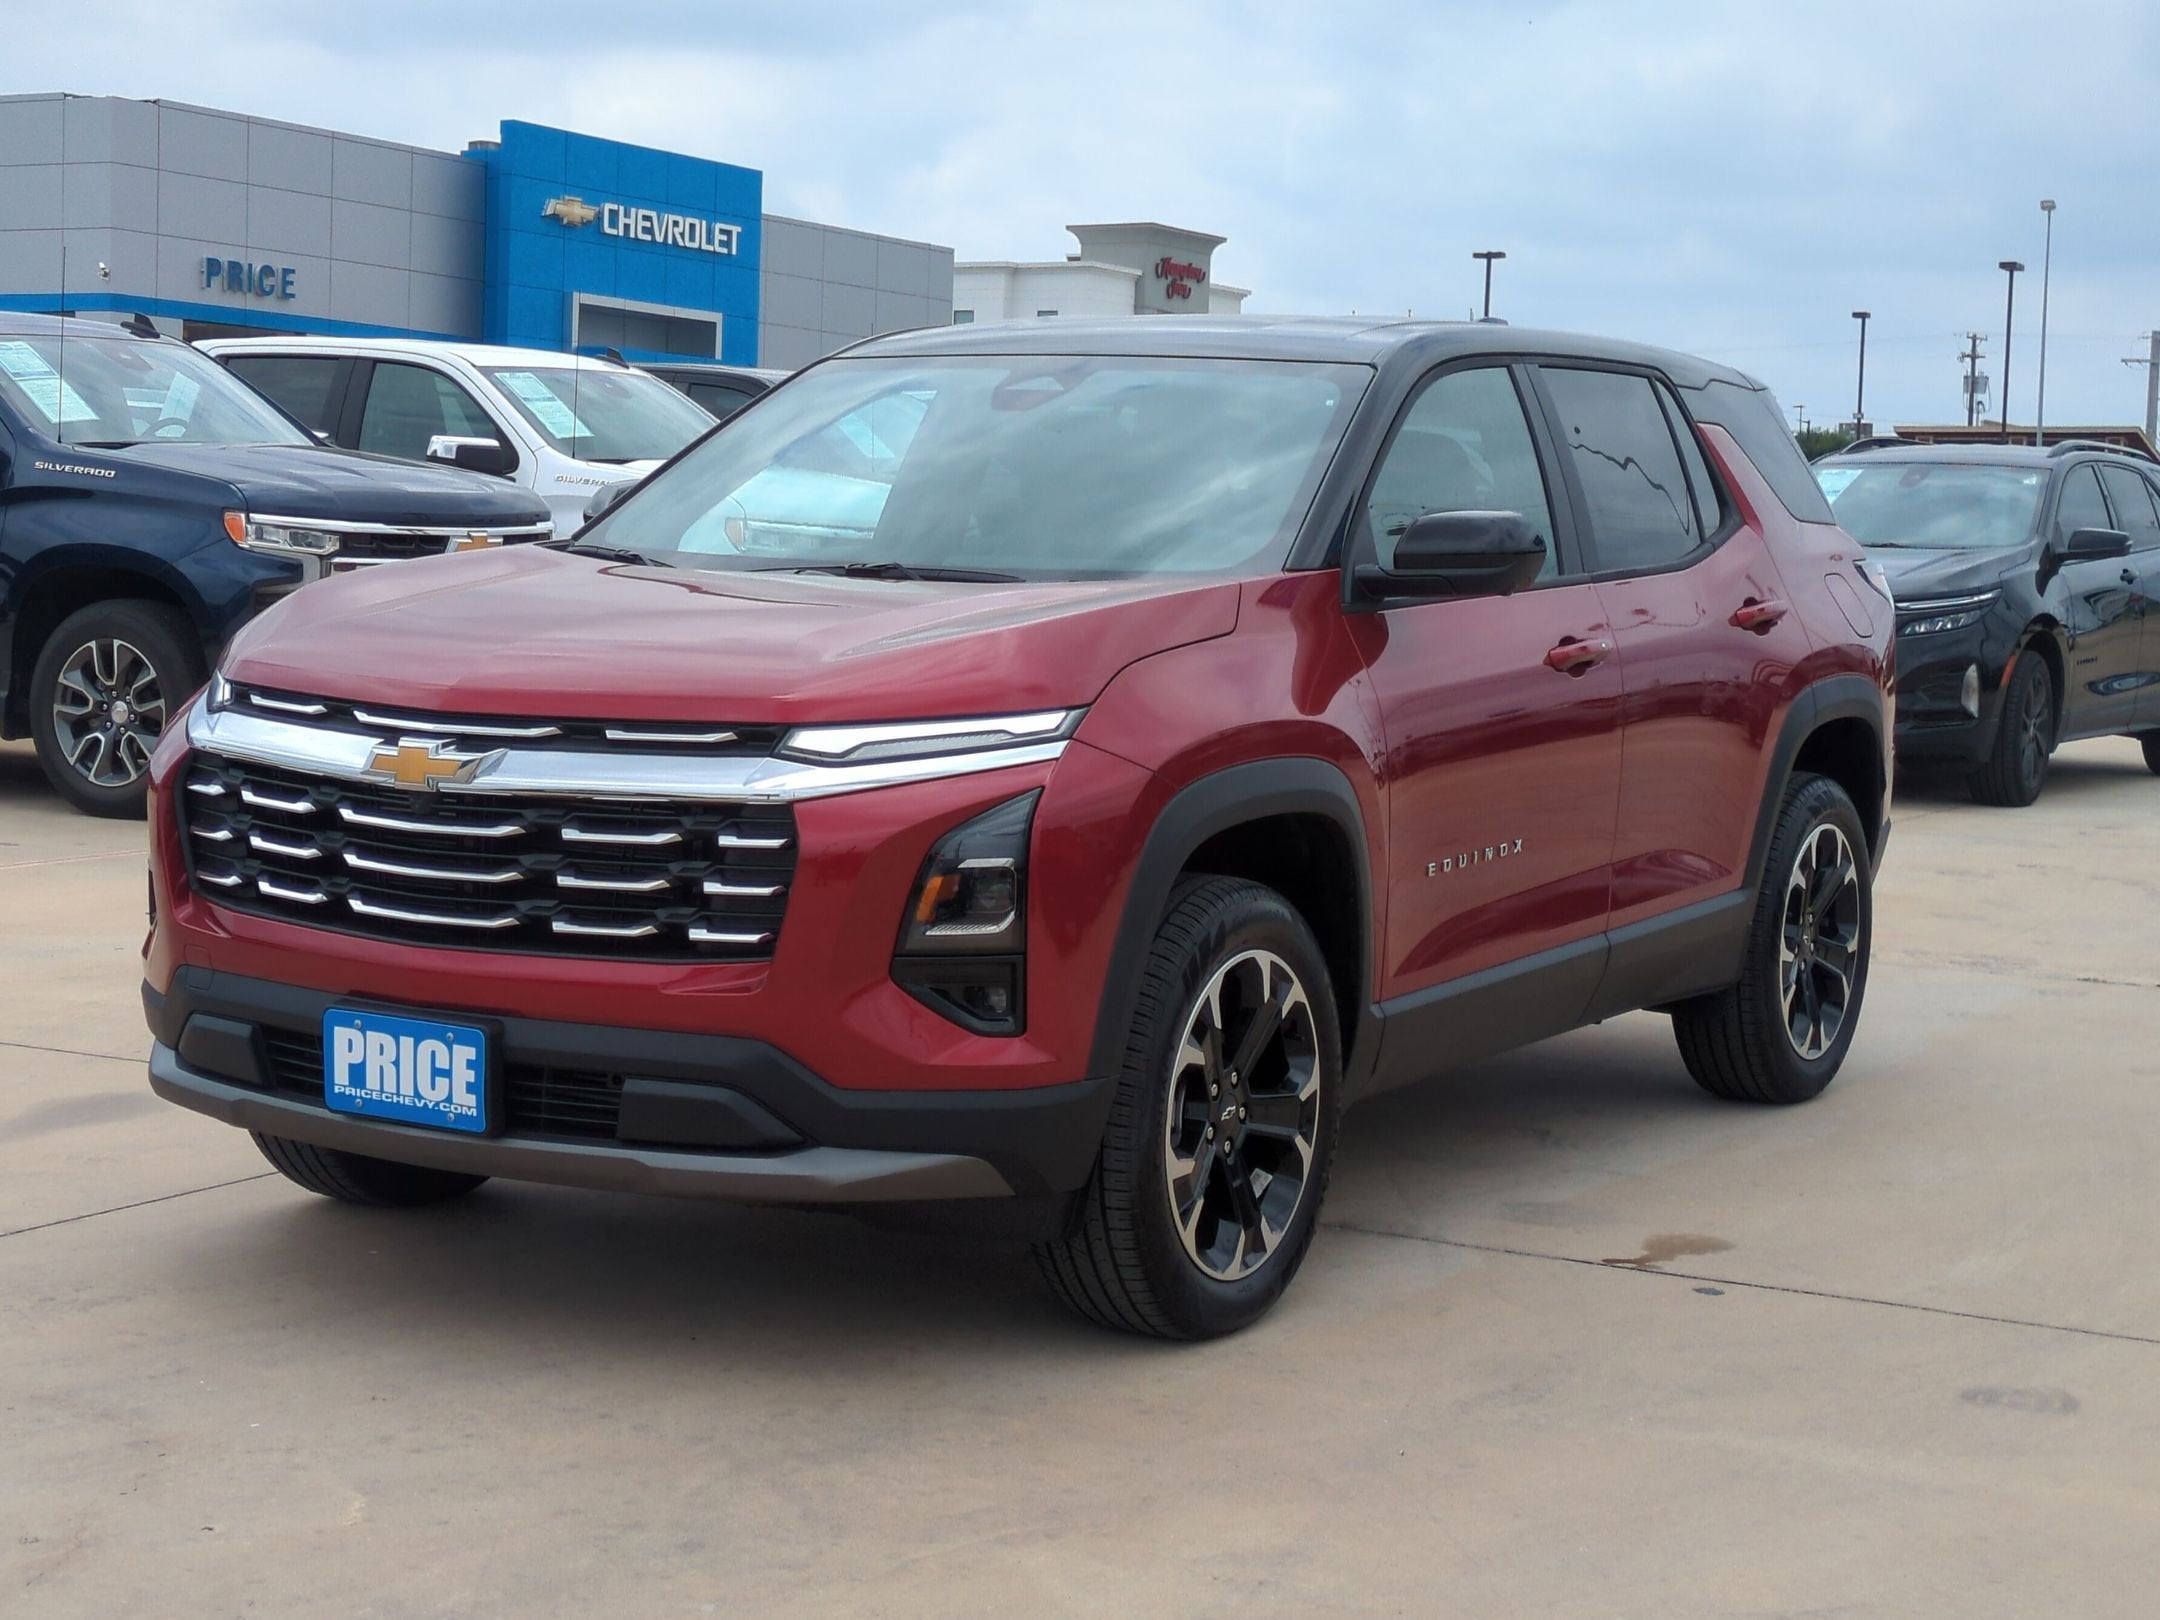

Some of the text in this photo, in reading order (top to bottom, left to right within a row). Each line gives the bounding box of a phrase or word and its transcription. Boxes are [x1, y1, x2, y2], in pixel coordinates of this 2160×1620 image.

[603, 203, 742, 255] CHEVROLET
[204, 257, 296, 299] PRICE
[33, 461, 116, 478] SILVERADO
[555, 475, 610, 486] SILVERA
[1426, 839, 1522, 877] EQUINOX
[333, 1026, 477, 1107] PRICE
[334, 1085, 478, 1117] PRICECHEVY.COM
